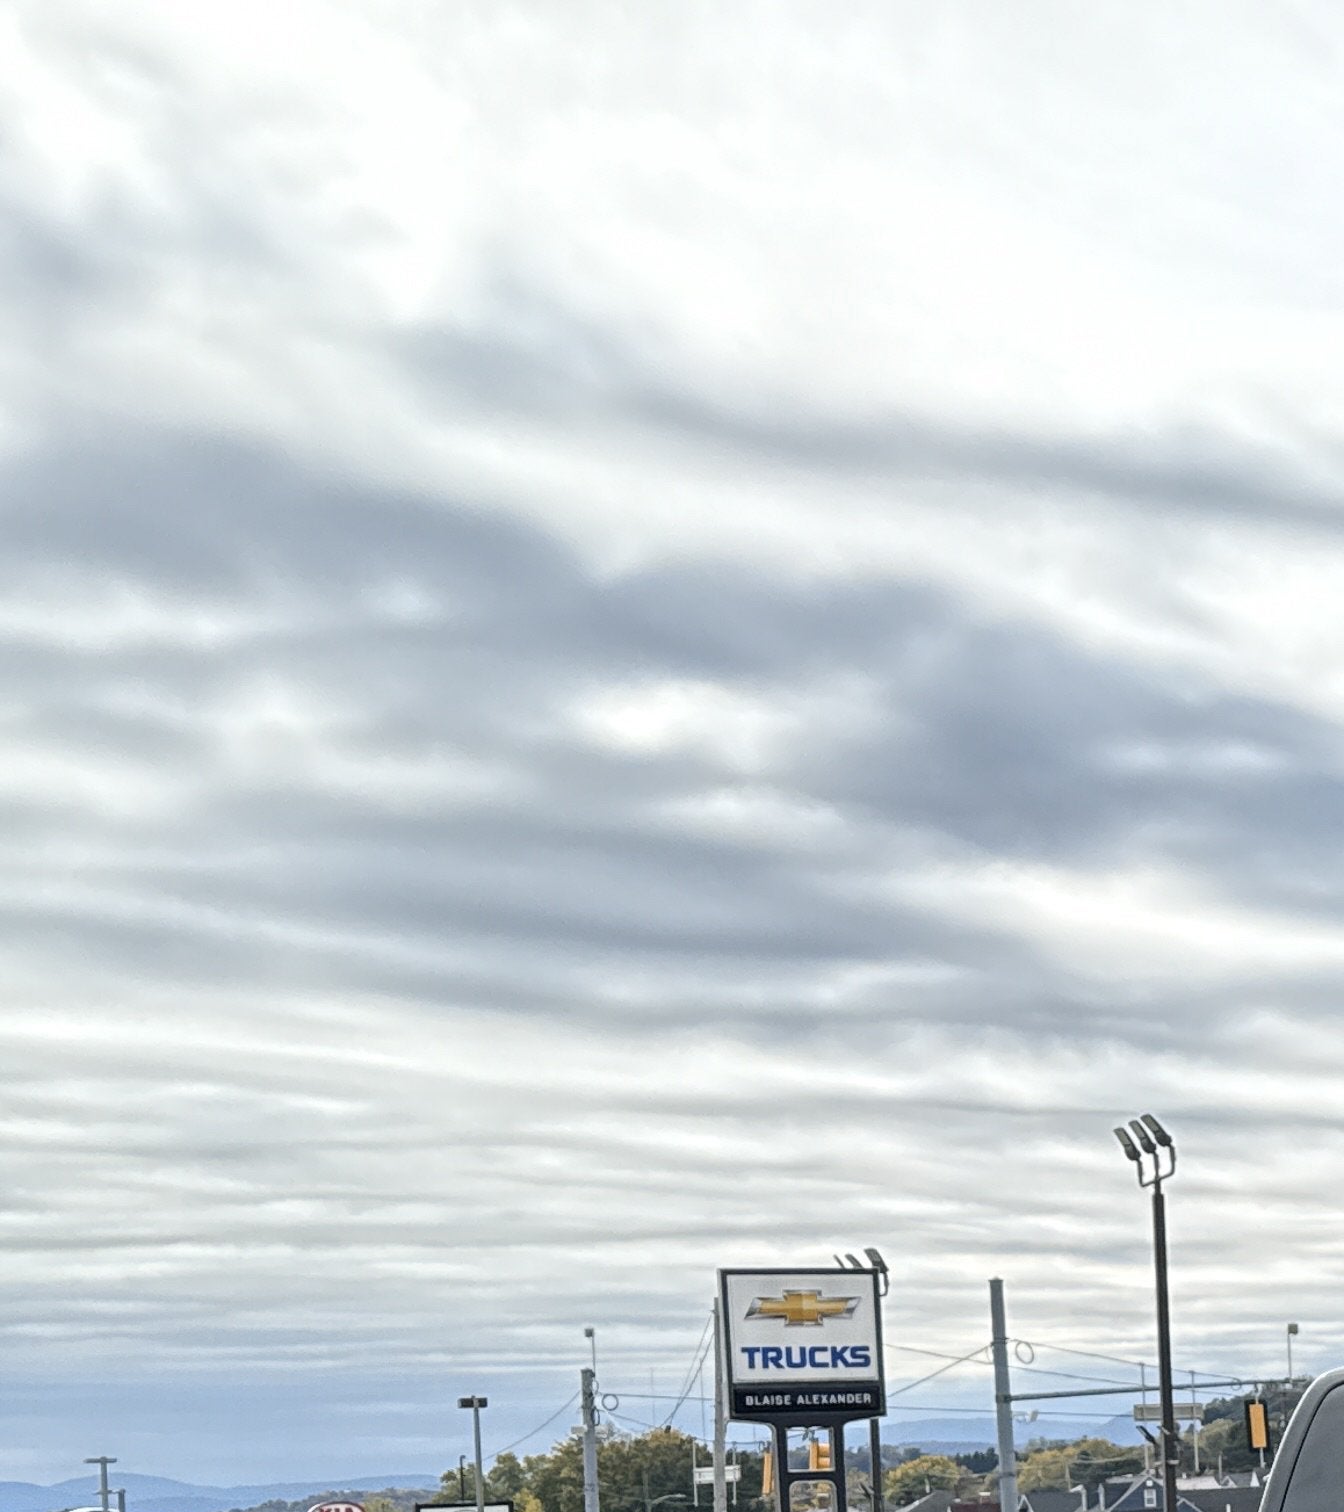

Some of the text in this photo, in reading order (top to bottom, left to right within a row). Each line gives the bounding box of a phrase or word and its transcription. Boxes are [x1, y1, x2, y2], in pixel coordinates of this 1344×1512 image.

[741, 1345, 871, 1369] TRUCKS
[745, 1392, 872, 1406] BLAISE ALEXANDER
